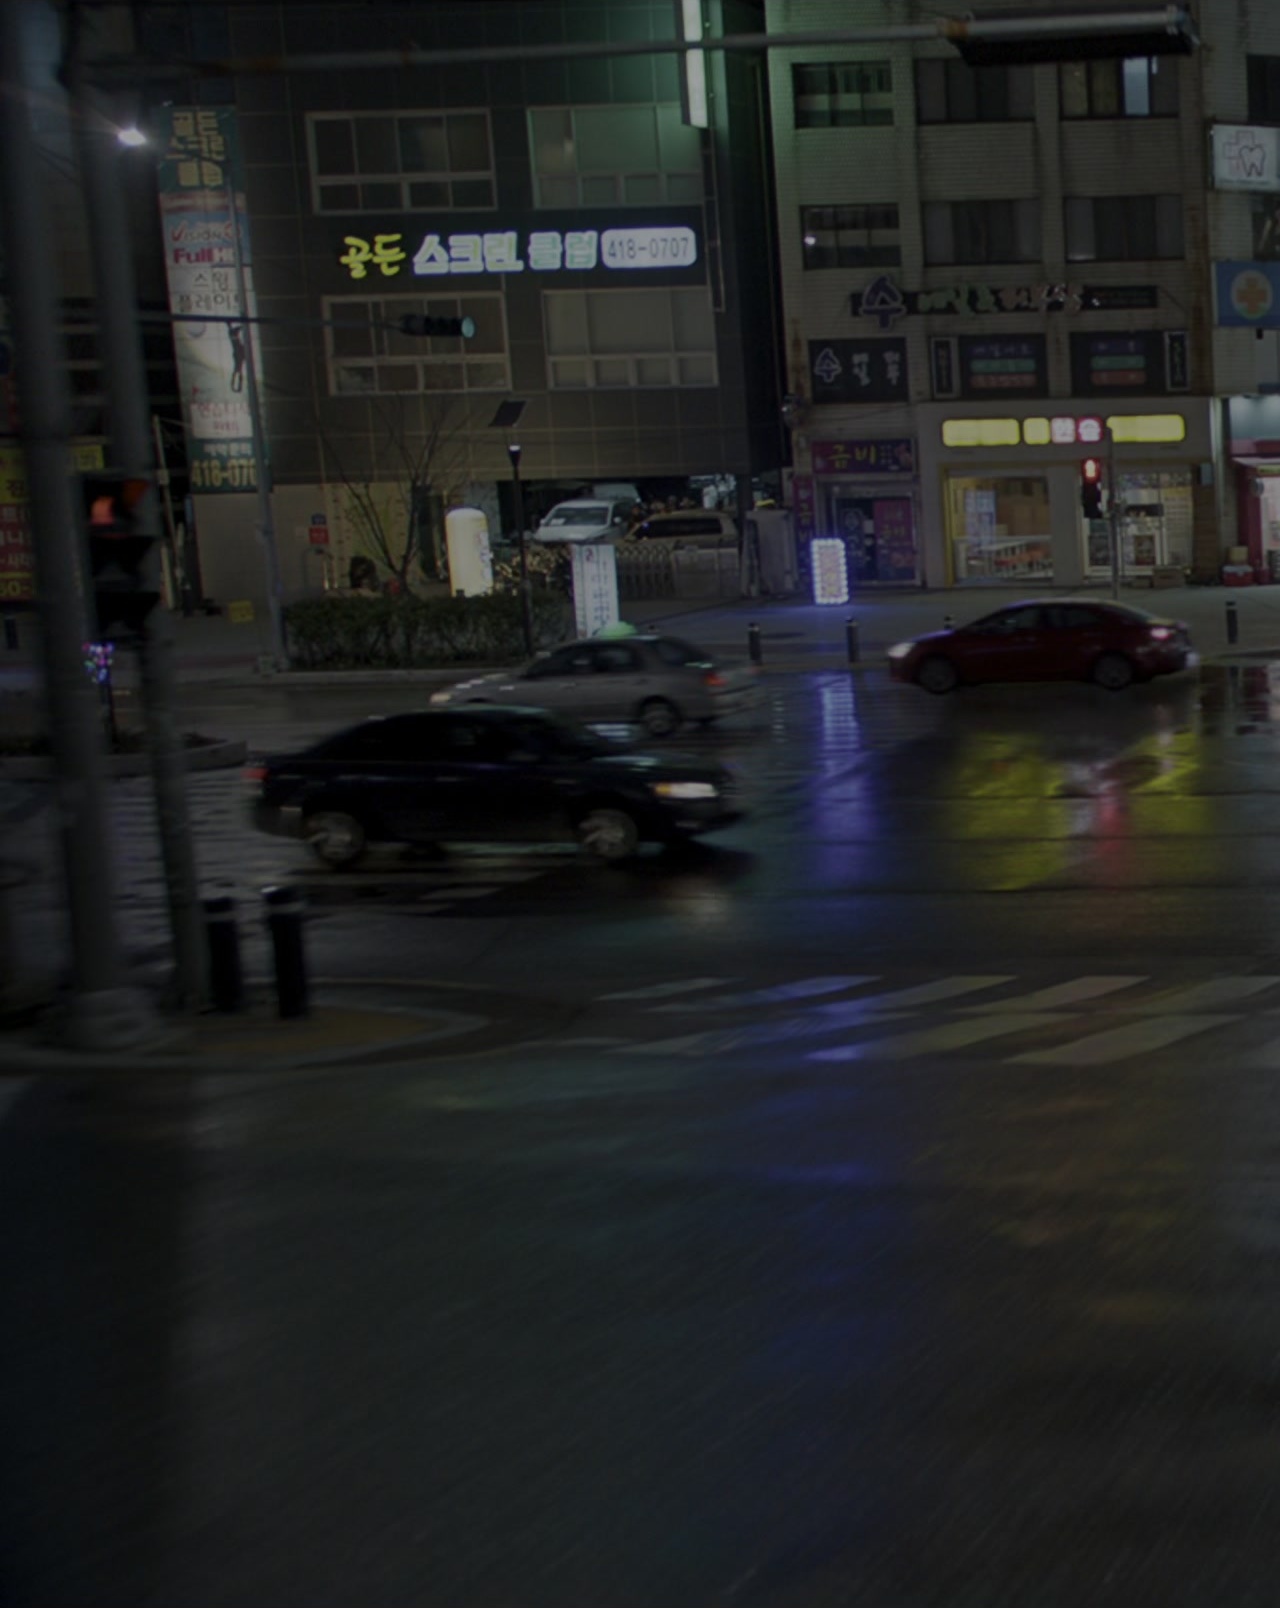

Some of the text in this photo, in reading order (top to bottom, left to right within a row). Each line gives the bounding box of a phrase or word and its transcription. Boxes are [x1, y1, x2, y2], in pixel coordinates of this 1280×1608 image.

[340, 230, 690, 279] 골든 스크린 클럽 418-0707
